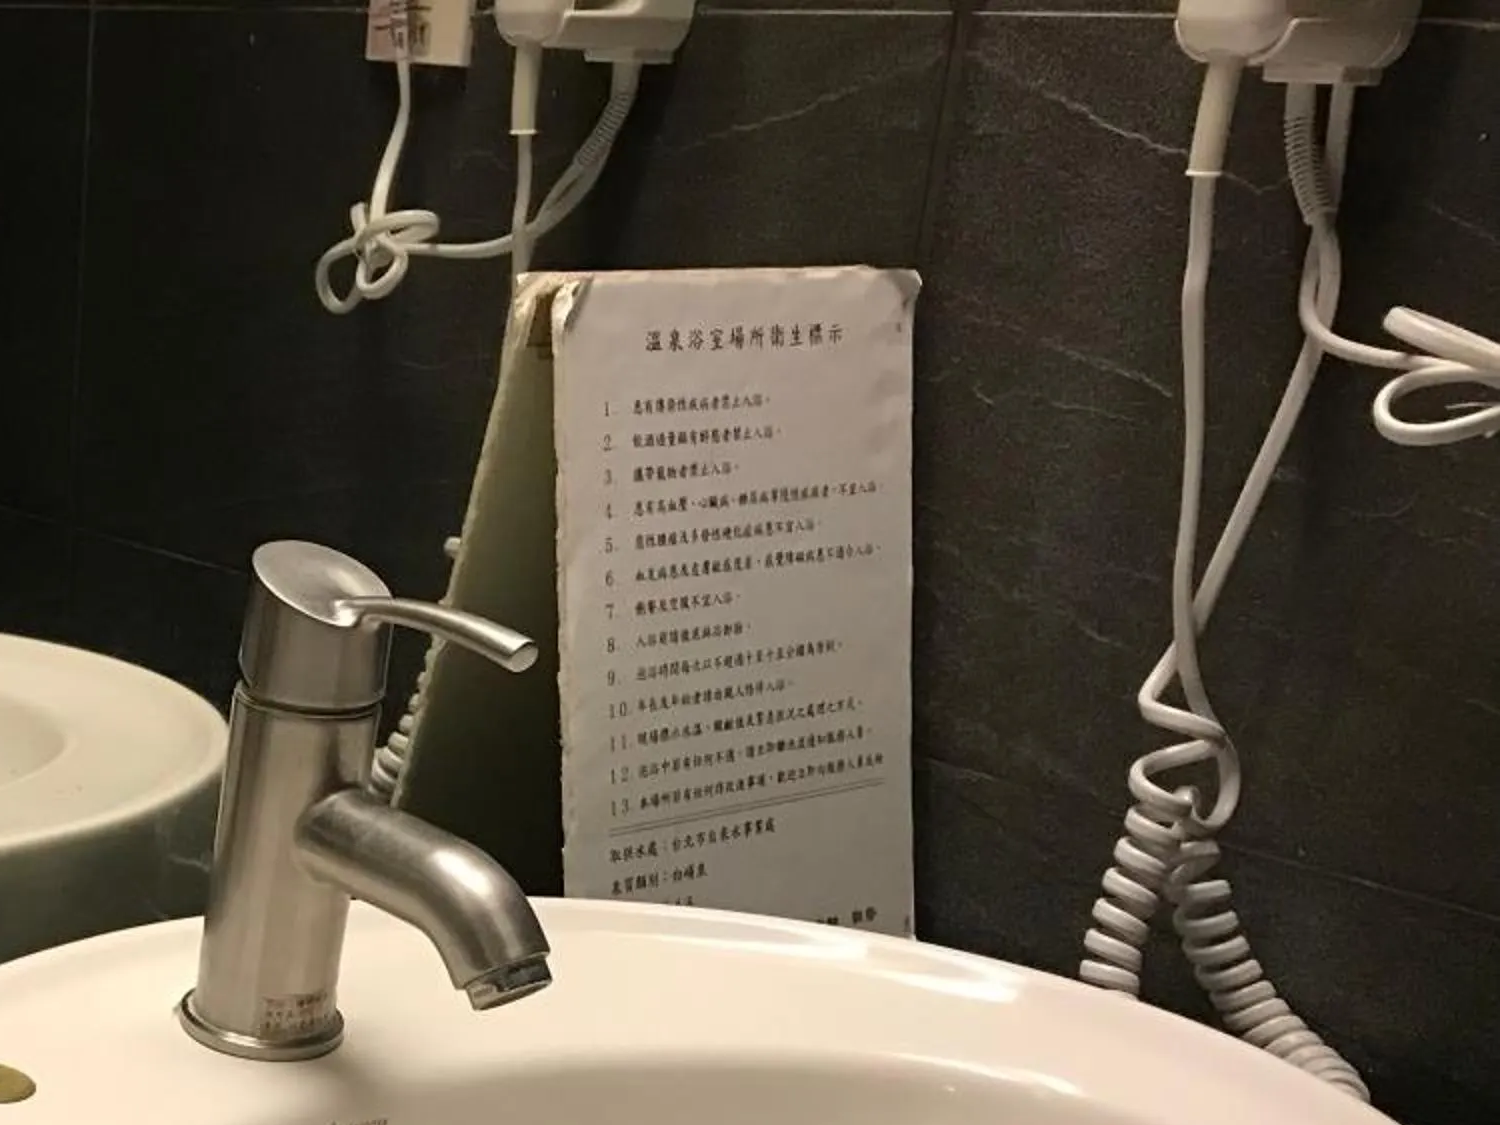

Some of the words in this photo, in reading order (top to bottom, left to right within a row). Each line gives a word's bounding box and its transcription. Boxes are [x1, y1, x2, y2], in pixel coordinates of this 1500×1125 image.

[644, 323, 845, 352] 溫泉浴室場所衛生標示
